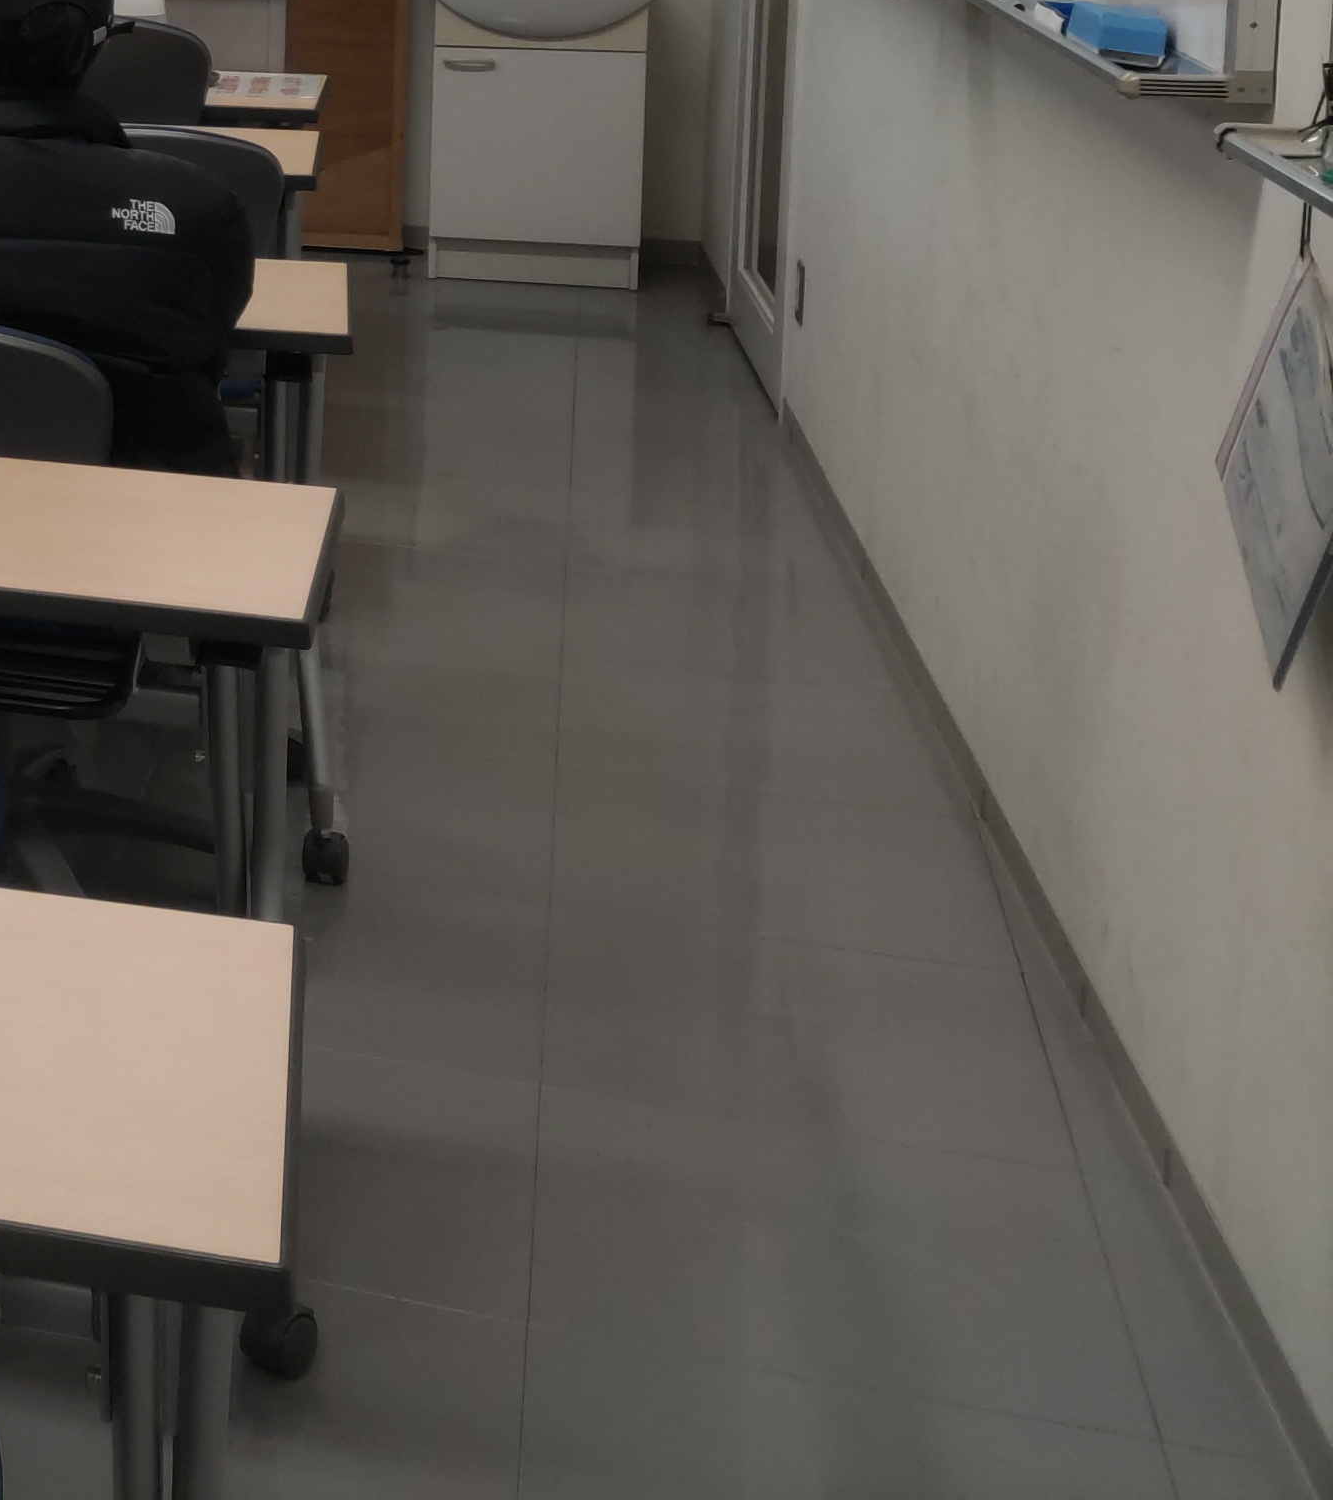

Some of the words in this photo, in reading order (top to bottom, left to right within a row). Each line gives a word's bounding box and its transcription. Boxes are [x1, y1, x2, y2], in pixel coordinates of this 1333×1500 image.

[129, 199, 154, 211] THE
[112, 208, 154, 221] NORTH
[124, 219, 154, 232] FACE
